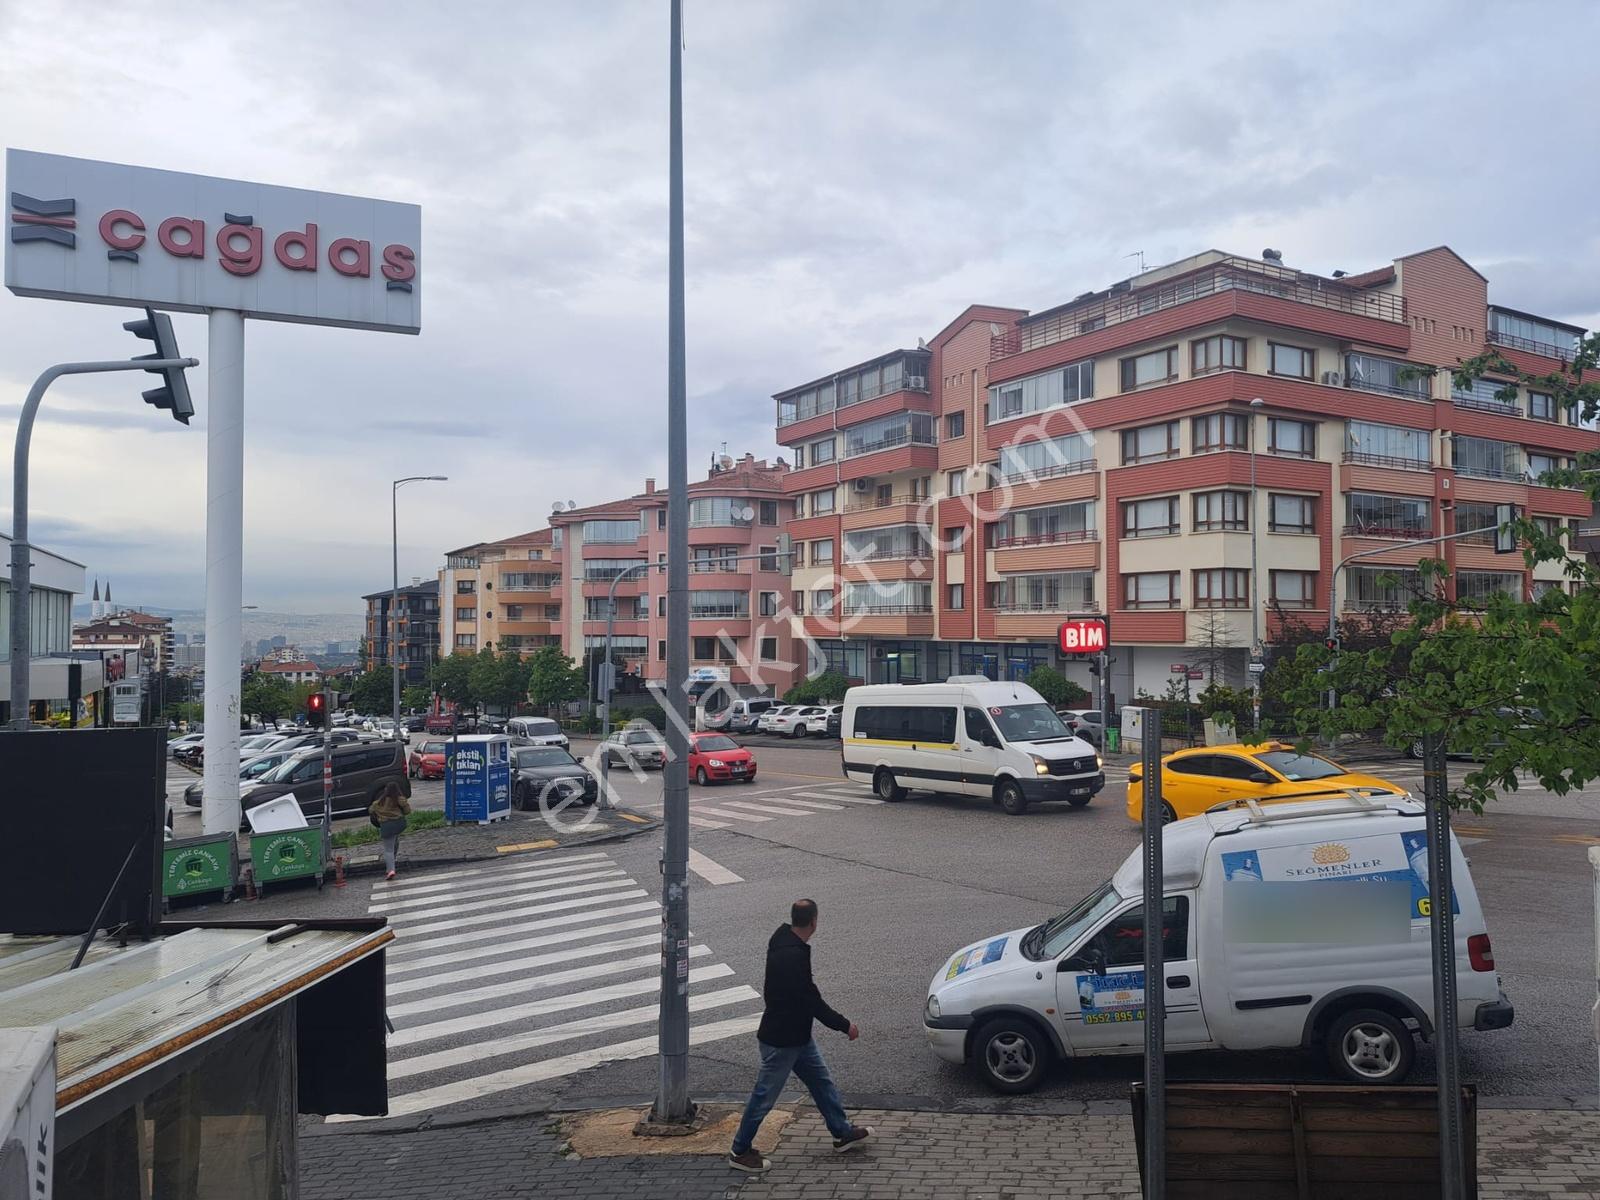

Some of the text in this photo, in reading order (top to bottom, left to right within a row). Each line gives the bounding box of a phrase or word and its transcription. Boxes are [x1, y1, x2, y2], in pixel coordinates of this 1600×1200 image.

[98, 209, 416, 294] çağdaş
[1065, 622, 1104, 648] BİM
[1285, 858, 1382, 877] SEĞMENLER
[1085, 1013, 1111, 1024] 0552
[1114, 1010, 1134, 1022] 895
